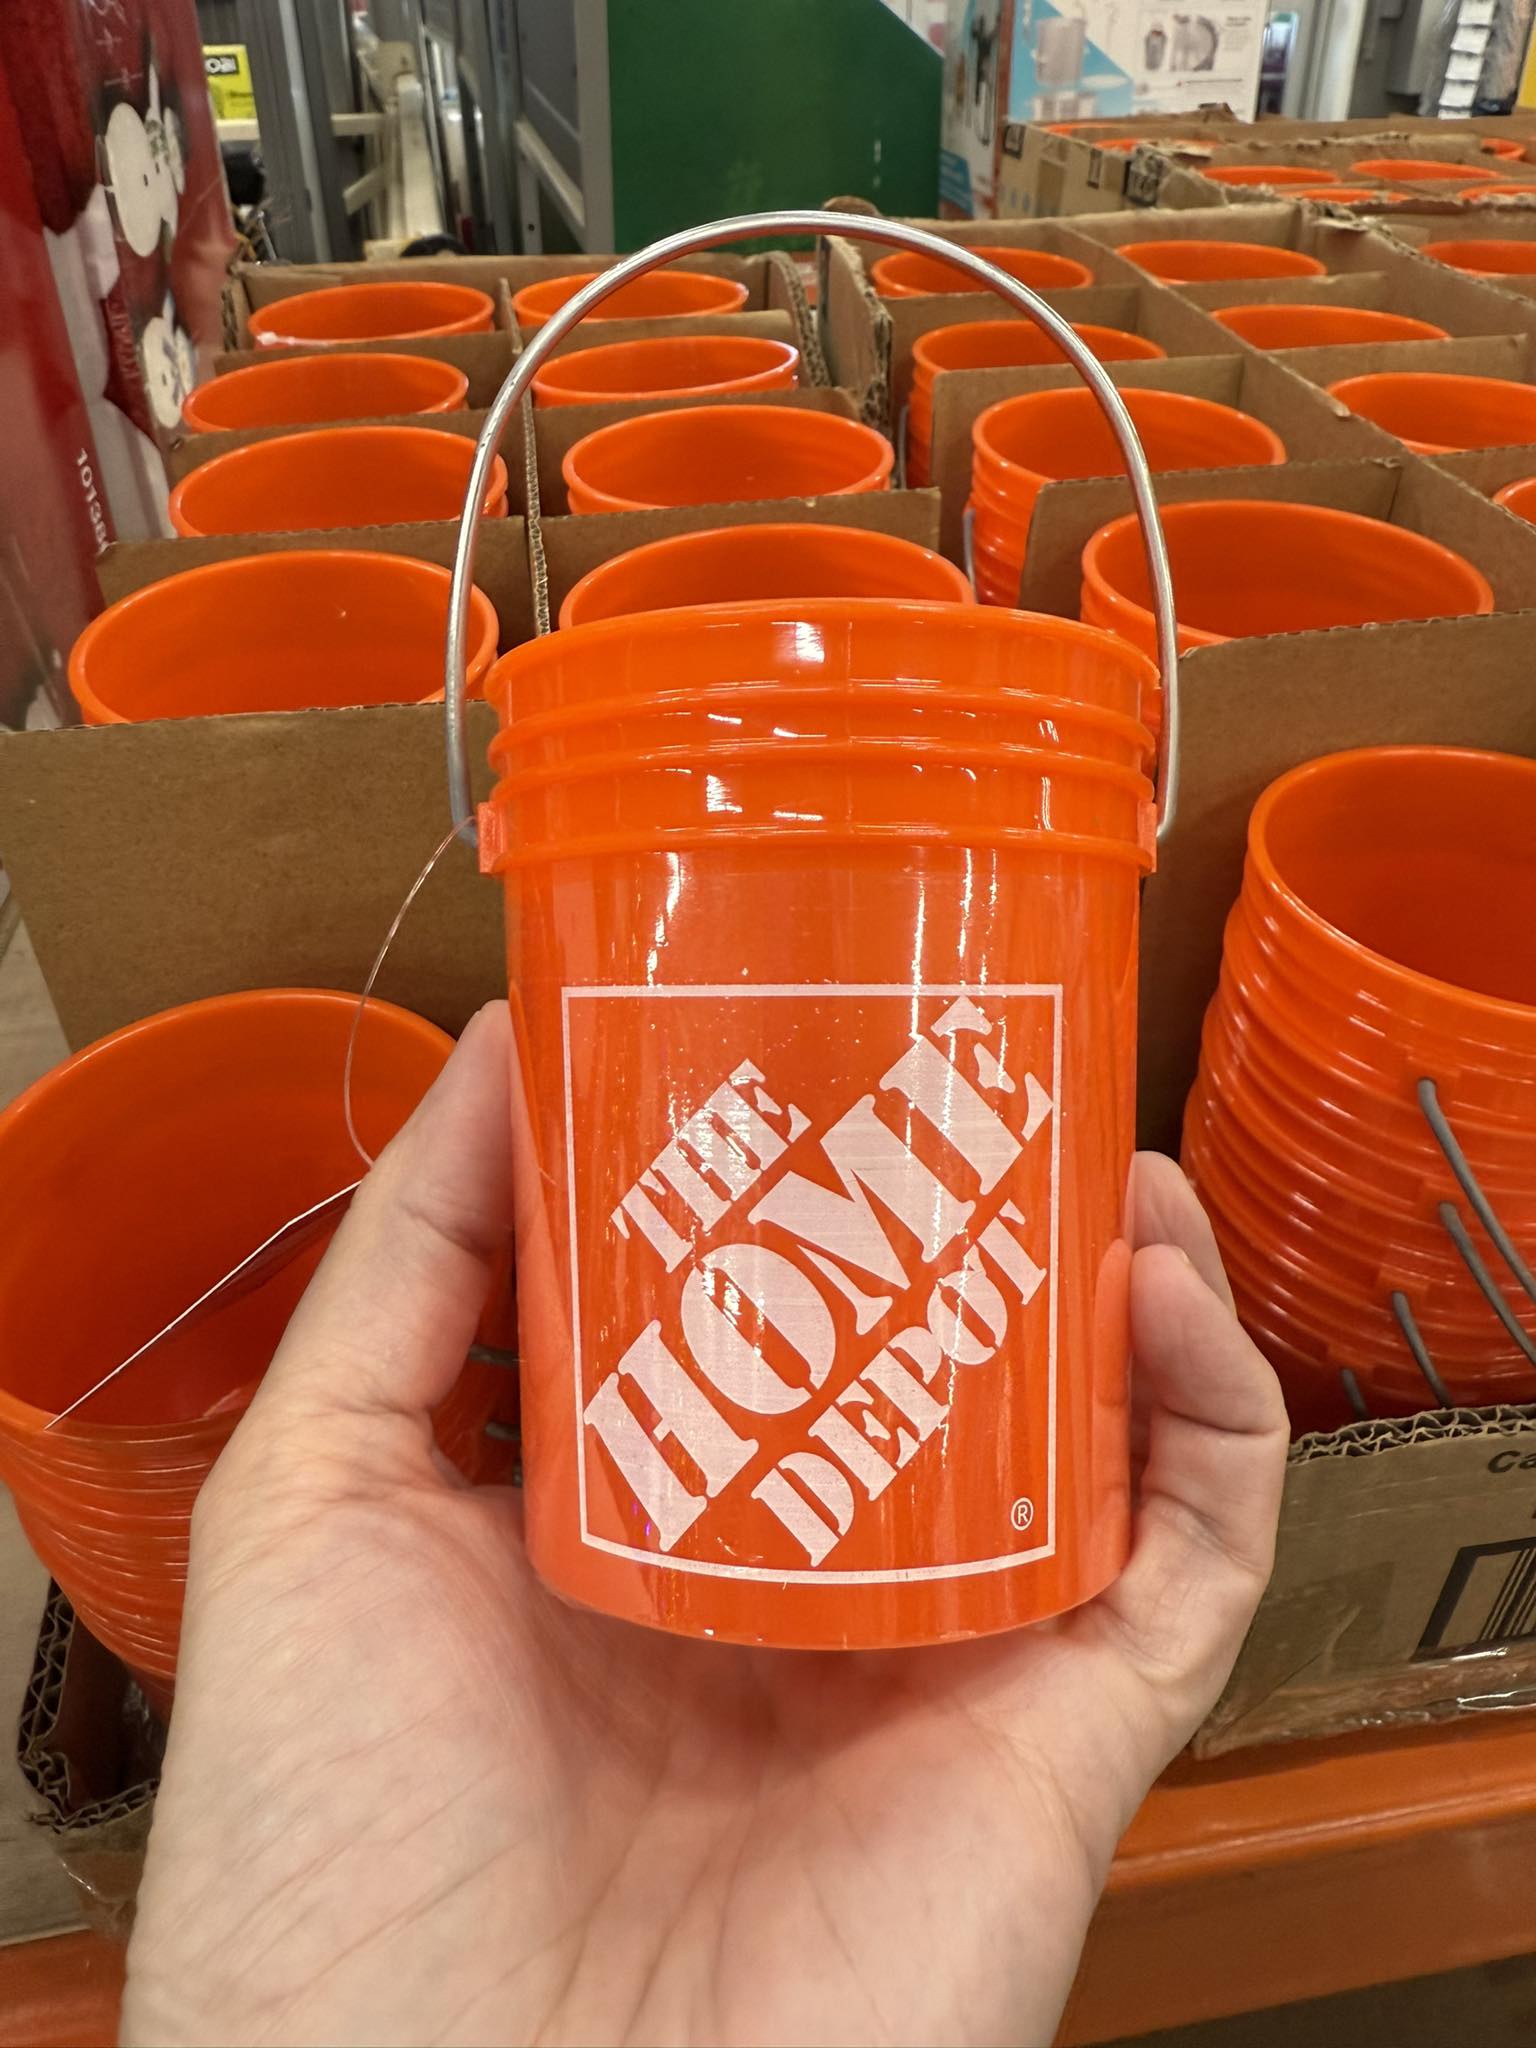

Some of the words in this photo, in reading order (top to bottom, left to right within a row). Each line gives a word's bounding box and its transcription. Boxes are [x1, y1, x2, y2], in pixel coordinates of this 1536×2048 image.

[584, 993, 1053, 1552] HOME
[610, 1058, 812, 1273] THE
[751, 1198, 1047, 1566] DEPOT
